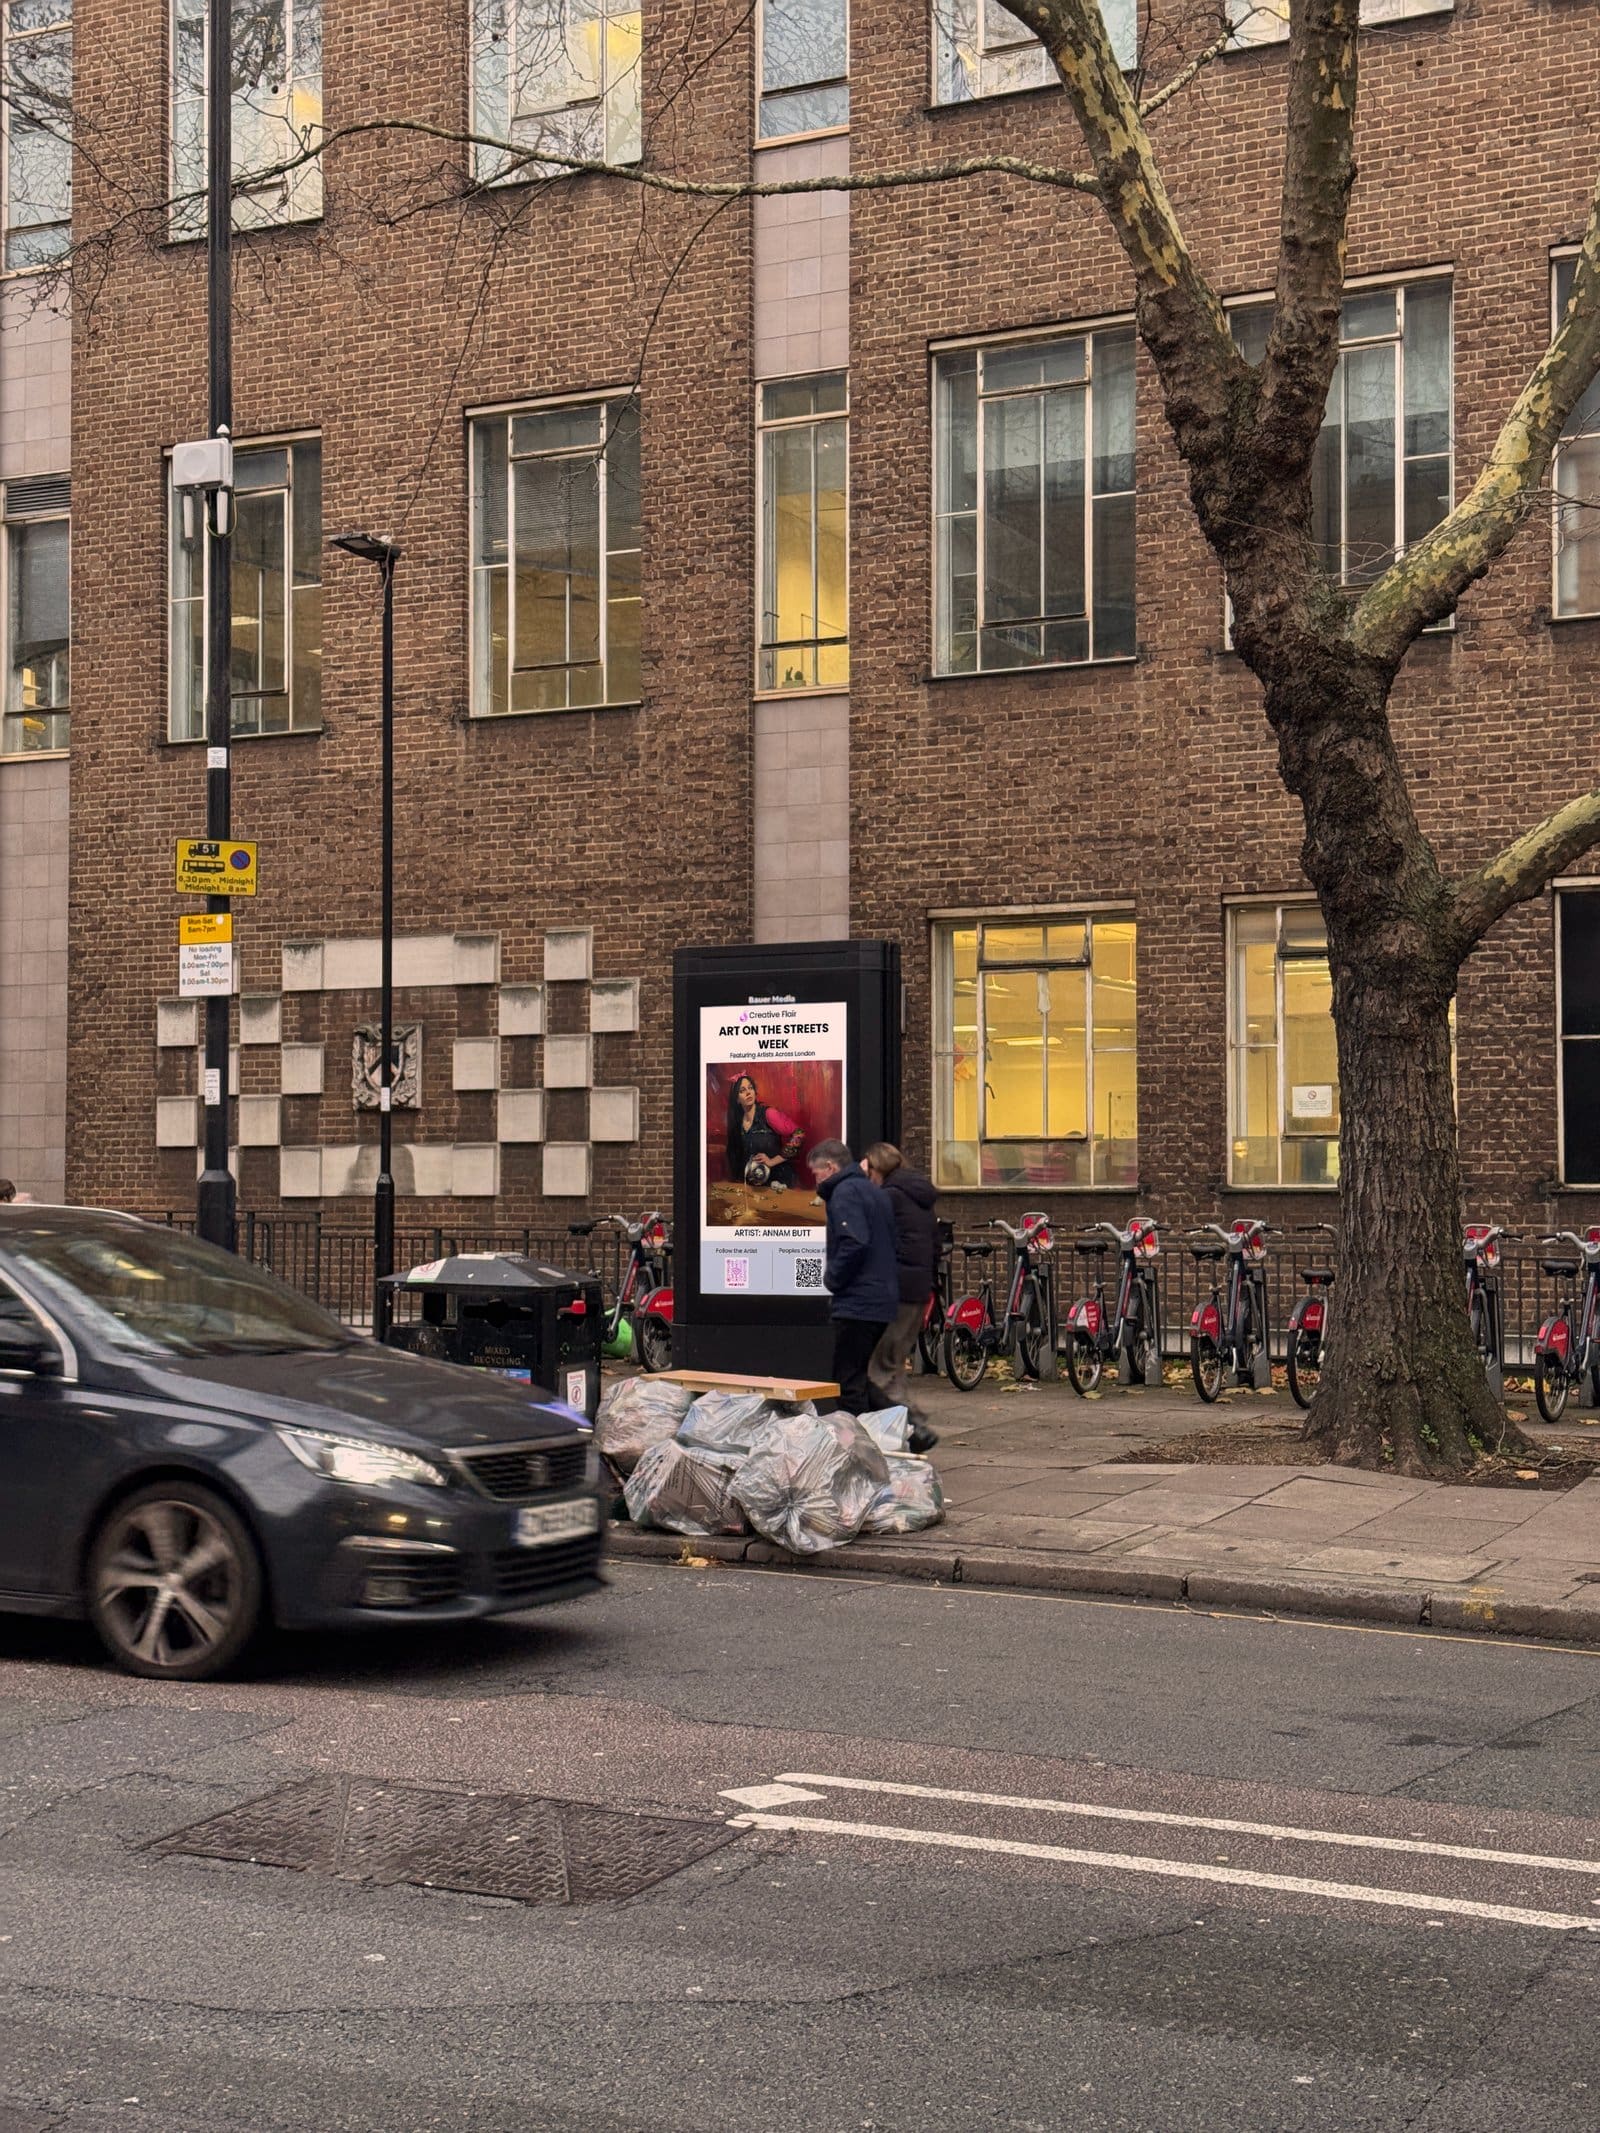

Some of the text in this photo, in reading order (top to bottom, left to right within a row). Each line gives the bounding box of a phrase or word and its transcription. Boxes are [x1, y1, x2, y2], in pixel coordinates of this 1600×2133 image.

[219, 877, 254, 886] Midnight
[185, 884, 220, 892] Midnight
[199, 946, 222, 954] loading
[748, 994, 796, 1004] Bauer Media
[749, 1010, 797, 1019] Creative Flair
[719, 1023, 829, 1036] ART ON THE STREETS
[758, 1039, 789, 1049] WEEK
[730, 1052, 756, 1060] Featuring
[734, 1229, 811, 1237] ARTIST: ANNAM BUTT
[473, 1356, 521, 1366] RECYCLING
